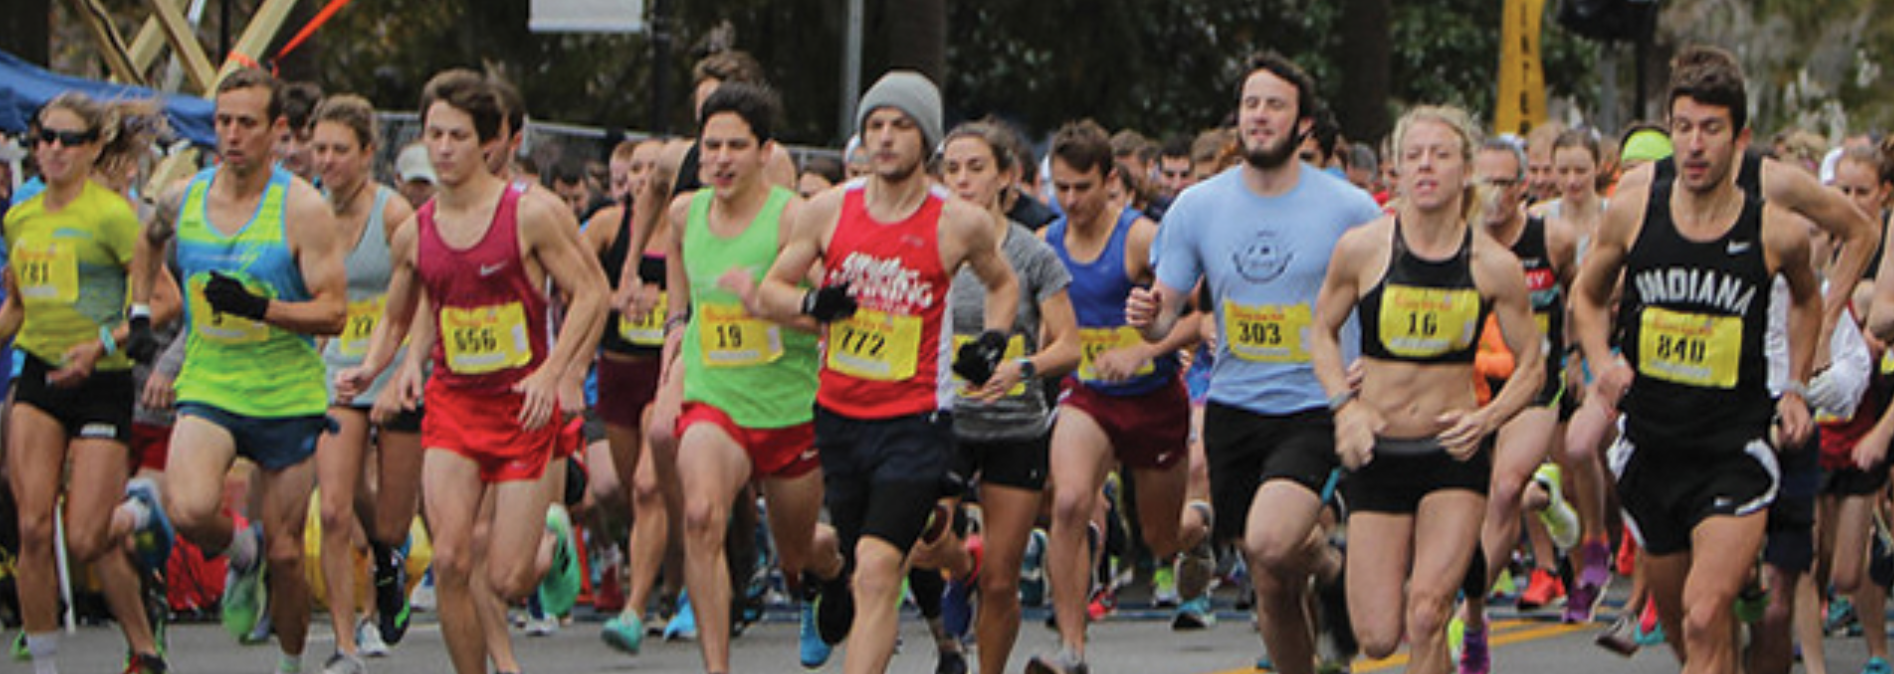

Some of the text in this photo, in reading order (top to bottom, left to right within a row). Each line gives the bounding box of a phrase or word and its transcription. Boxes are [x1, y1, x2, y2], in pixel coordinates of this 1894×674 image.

[1635, 267, 1757, 316] INDIANA
[716, 325, 742, 348] 19
[840, 326, 885, 358] 772
[1238, 321, 1282, 345] 303
[1656, 333, 1706, 364] 840
